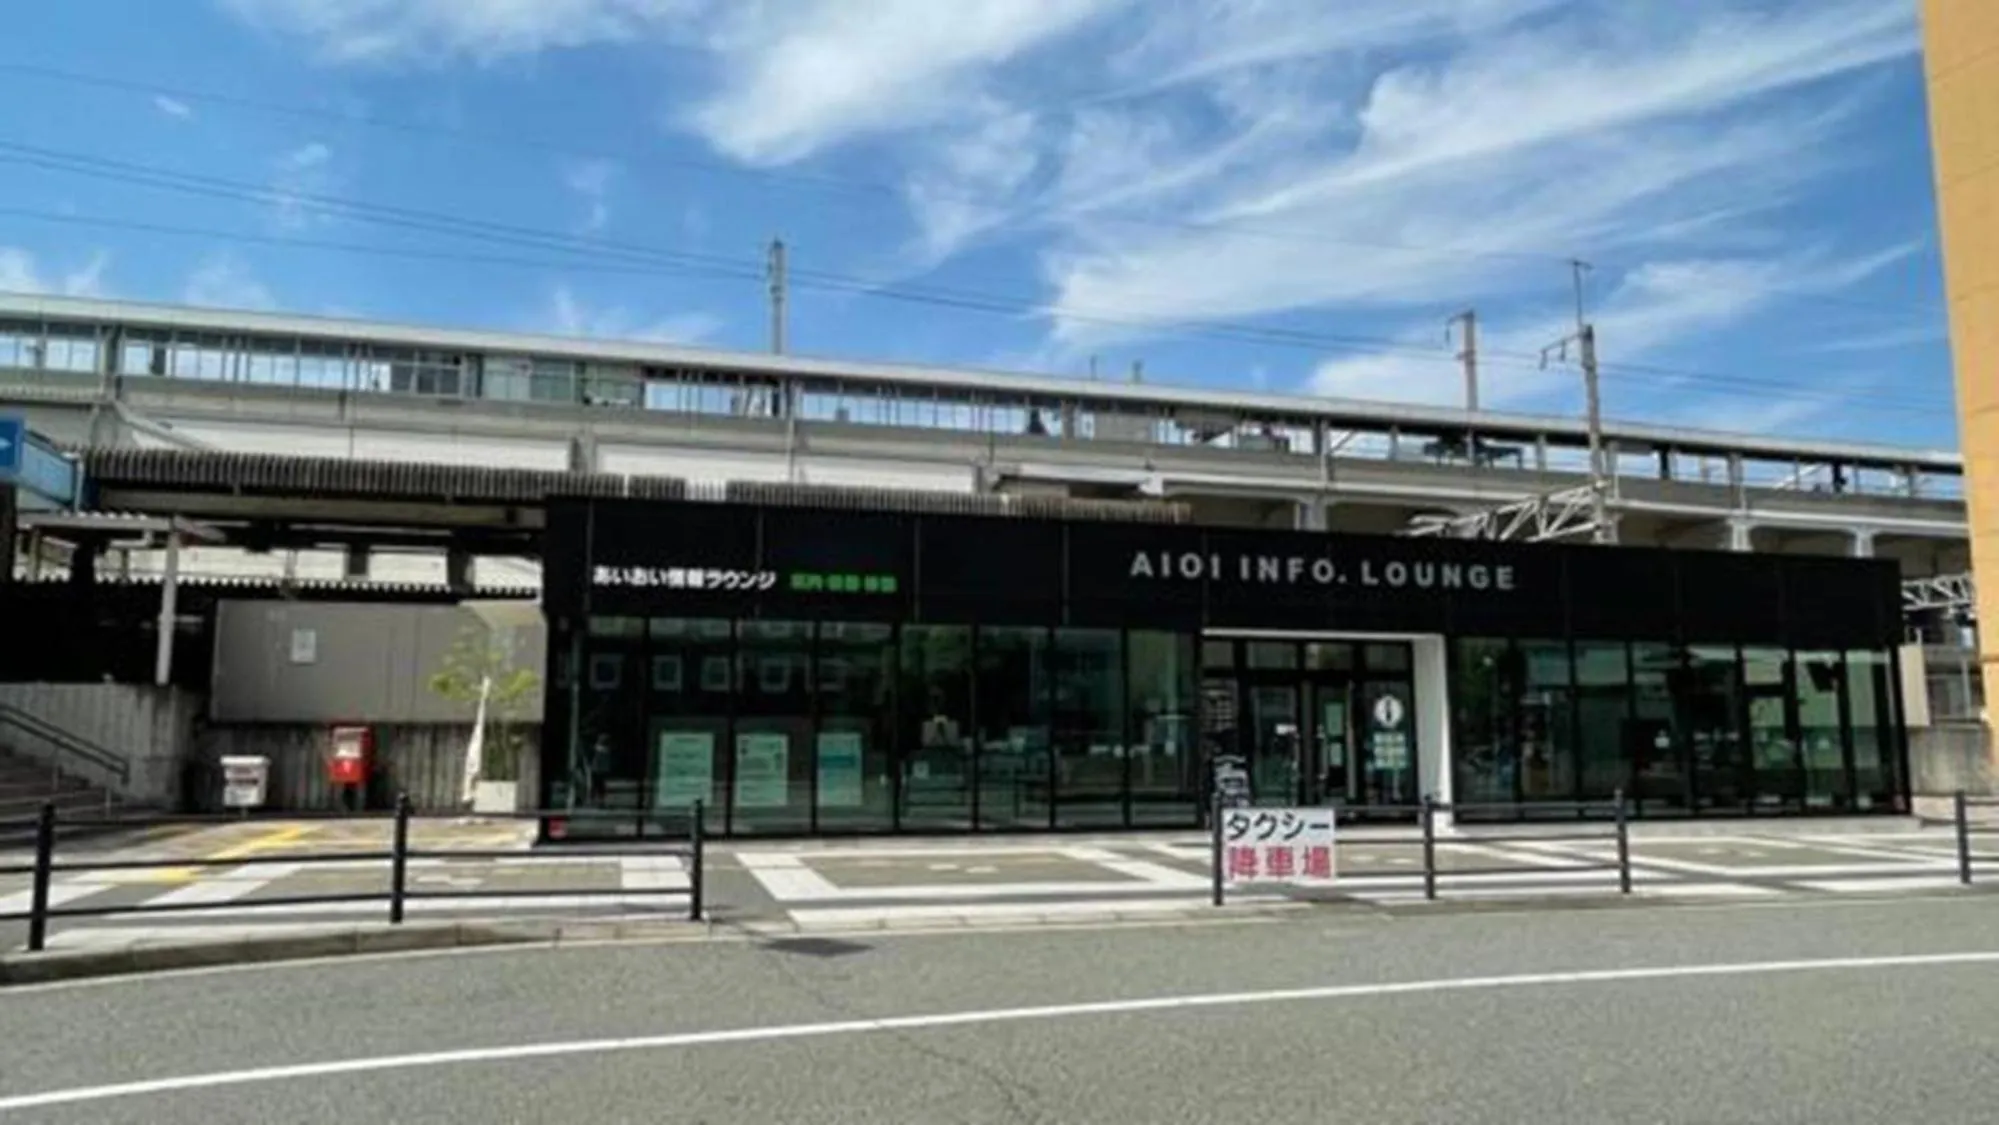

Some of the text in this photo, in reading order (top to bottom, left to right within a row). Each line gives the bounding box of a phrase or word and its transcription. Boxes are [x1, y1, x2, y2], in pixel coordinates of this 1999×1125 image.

[1130, 551, 1515, 590] AIOI INFO. LOUNGE
[1226, 811, 1330, 840] タクシー
[1227, 845, 1332, 880] 降車場
